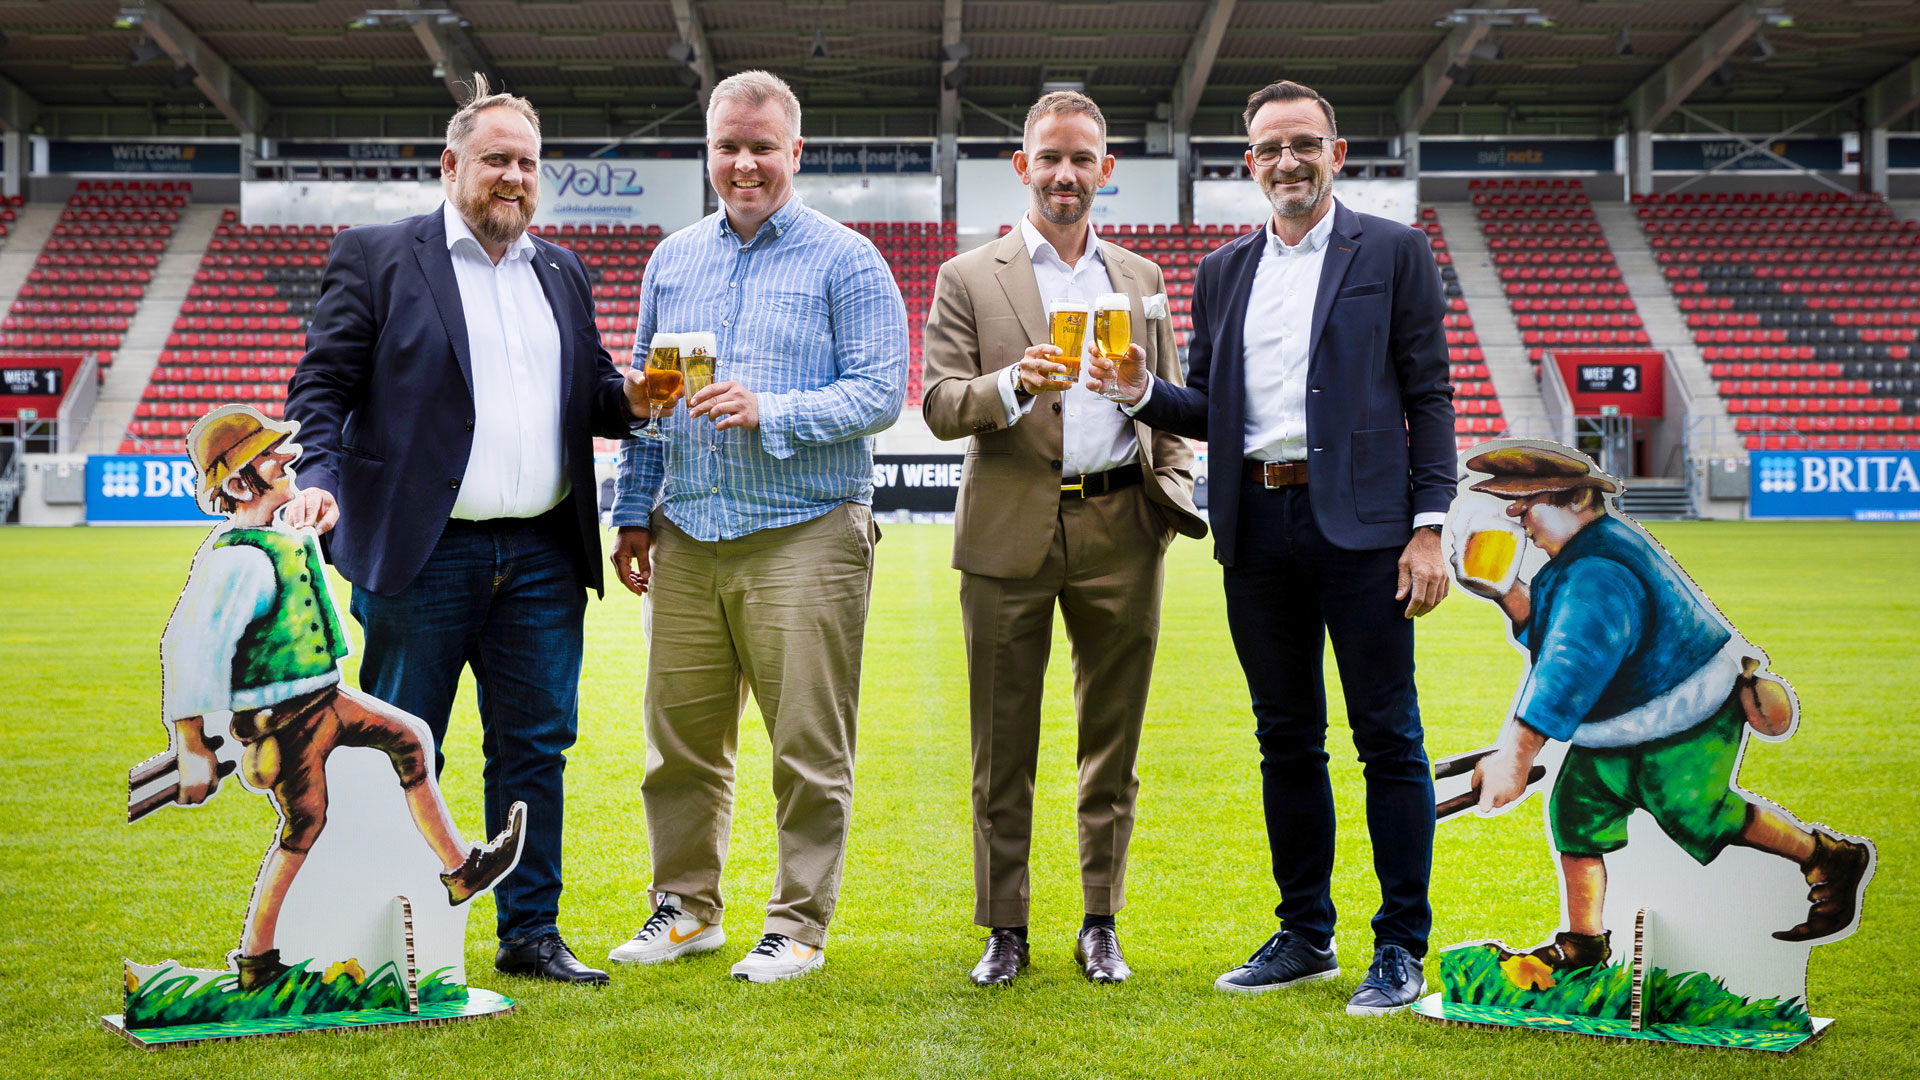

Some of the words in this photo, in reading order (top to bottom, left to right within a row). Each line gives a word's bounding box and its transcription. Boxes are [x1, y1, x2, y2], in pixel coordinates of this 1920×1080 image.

[3, 369, 36, 384] WEST
[44, 370, 56, 394] 1
[1582, 367, 1614, 381] WEST
[1622, 367, 1637, 391] 3
[873, 463, 899, 488] SV
[901, 463, 964, 488] WEHE
[1800, 456, 1920, 492] BRITA
